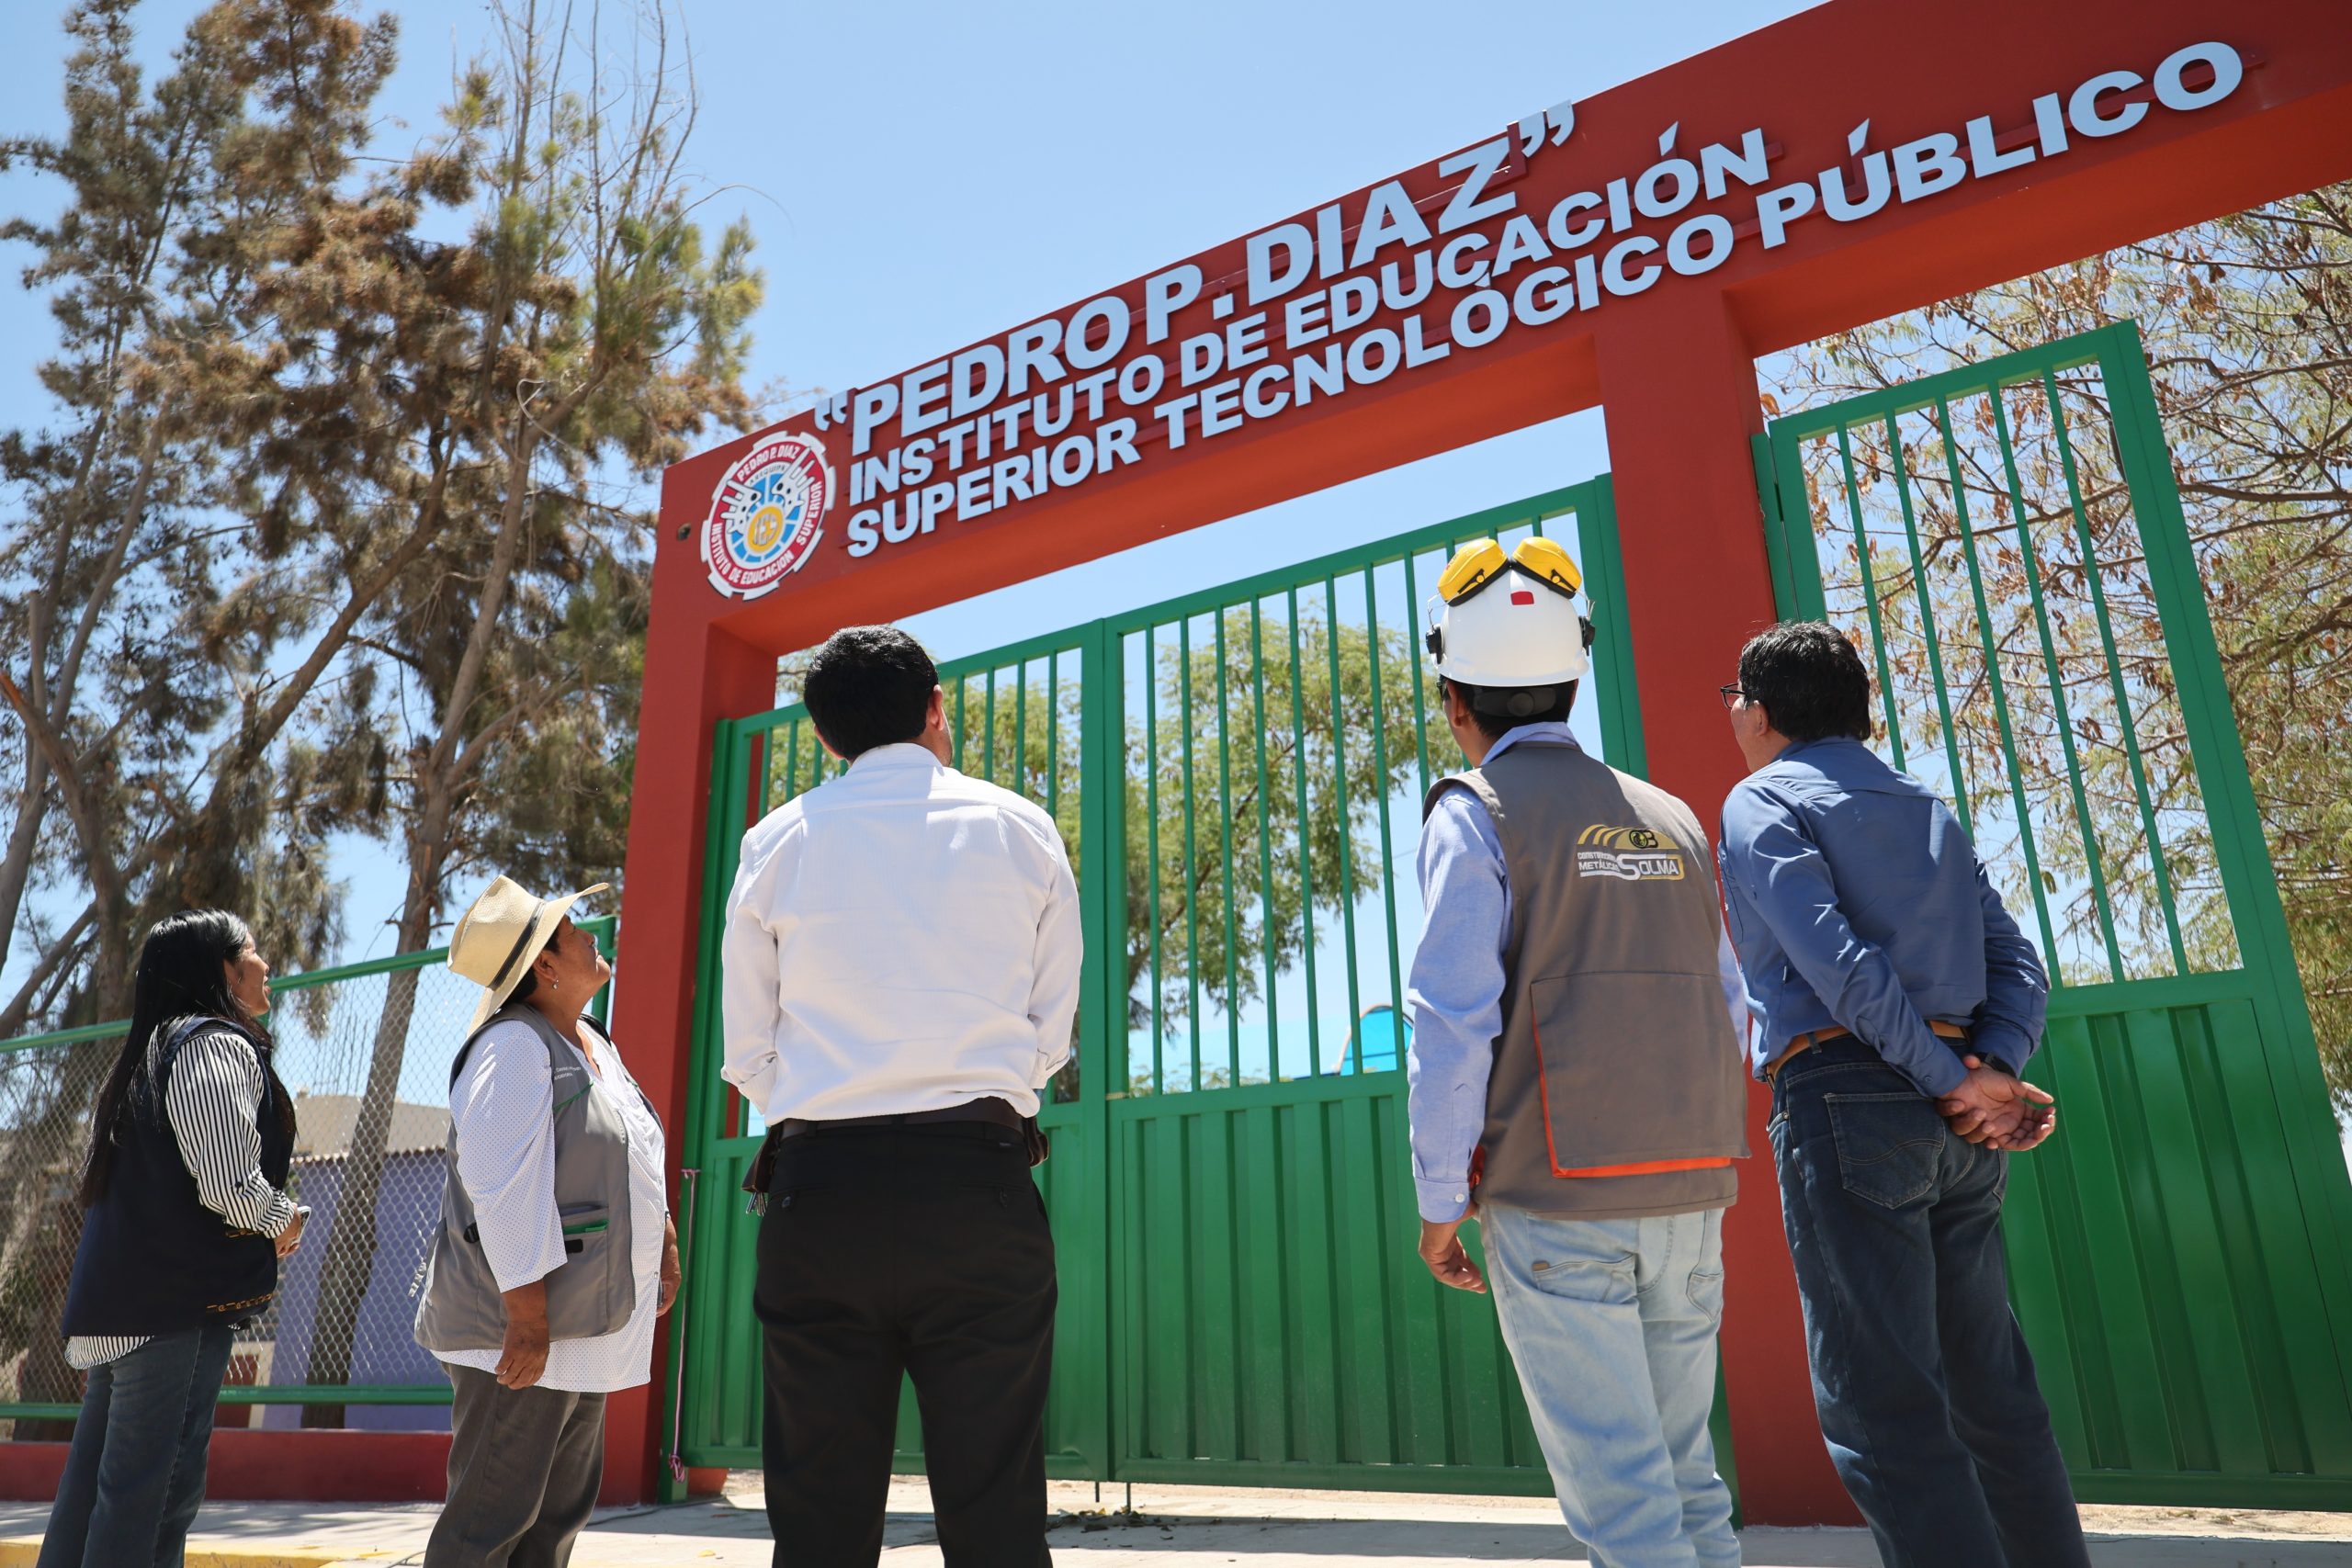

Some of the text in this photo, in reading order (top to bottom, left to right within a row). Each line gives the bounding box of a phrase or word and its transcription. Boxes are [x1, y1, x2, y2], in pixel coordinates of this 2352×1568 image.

[848, 41, 2243, 558] SUPERIOR TECNOLÓGICO PÚBLICO
[850, 121, 1770, 505] INSTITUTO DE EDUCACIÓN
[1147, 265, 1234, 344] P.
[737, 449, 770, 482] PEDRO
[777, 445, 800, 459] DIAZ
[711, 480, 823, 585] INSTITUTO DE EDUCACION SUPERIOR
[1616, 853, 1679, 880] SOLMA
